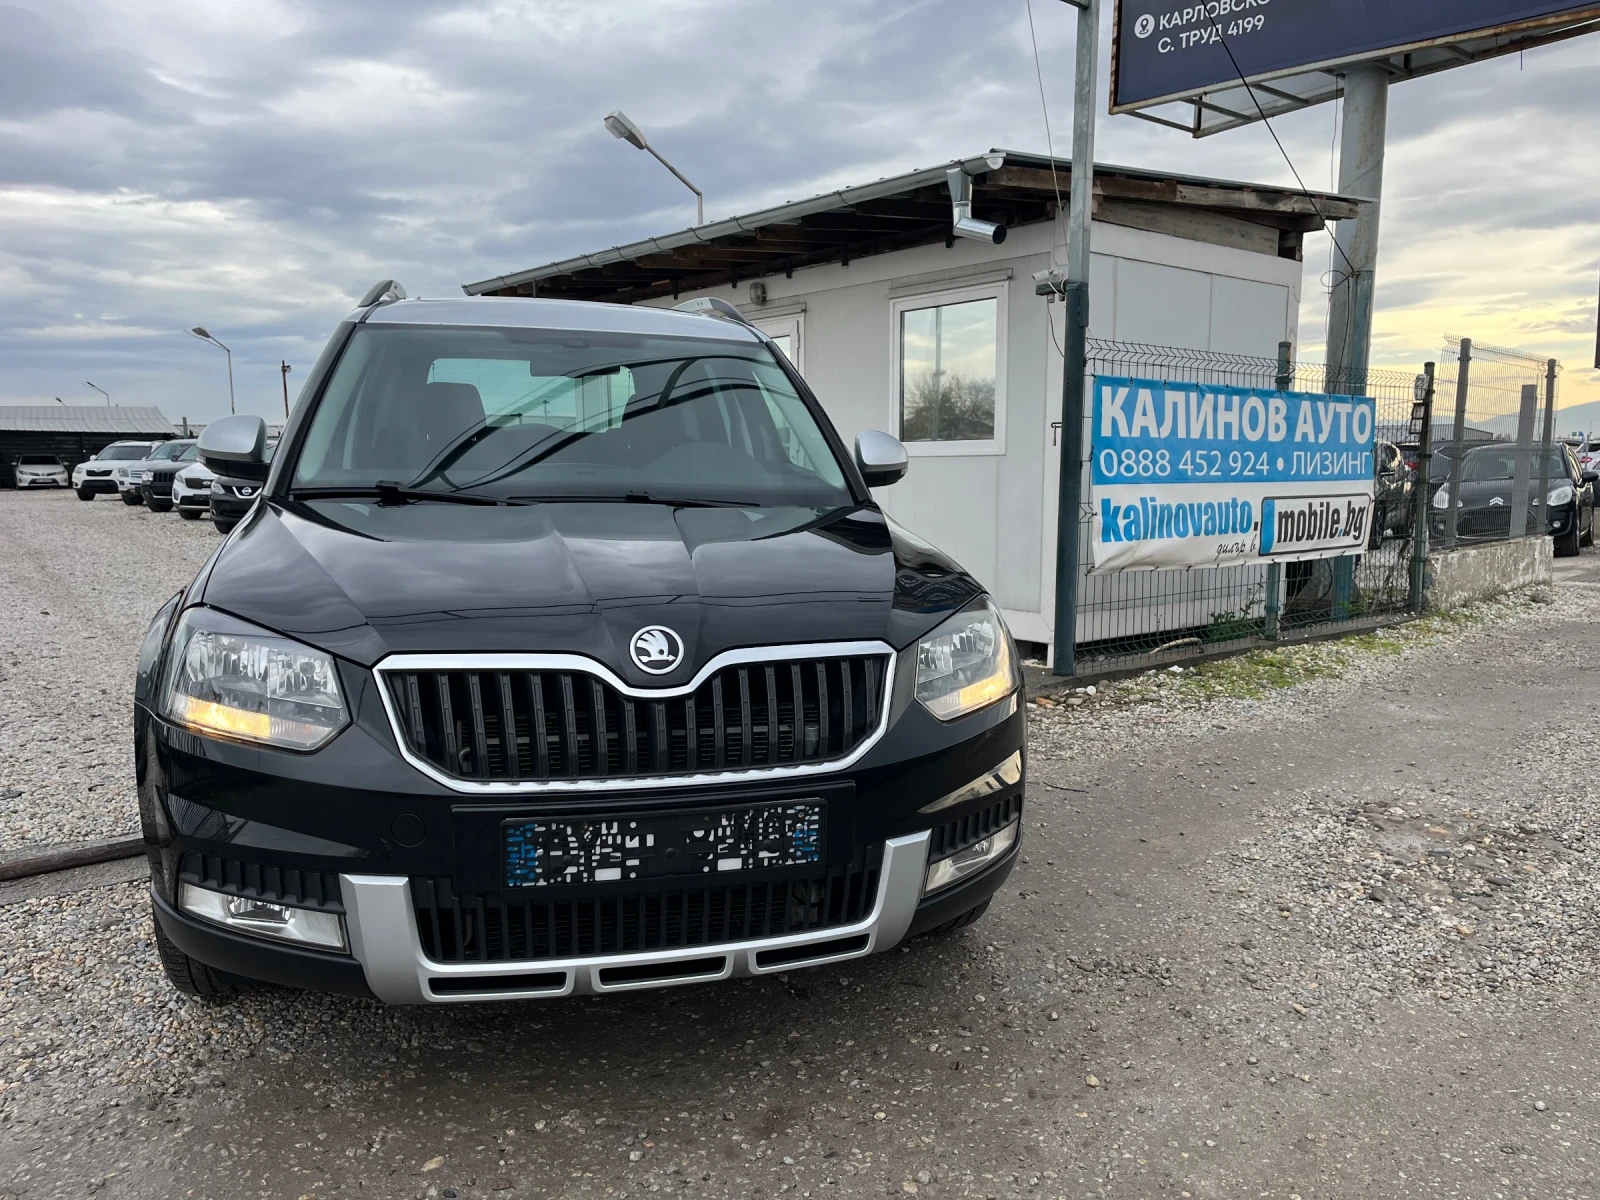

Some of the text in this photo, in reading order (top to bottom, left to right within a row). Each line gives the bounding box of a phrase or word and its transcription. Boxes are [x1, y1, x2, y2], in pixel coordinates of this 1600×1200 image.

[1159, 0, 1271, 31] КАРЛОВСК
[1157, 14, 1265, 53] С. ТРУД 4199
[1101, 385, 1371, 444] КАЛИНОВ АУТО
[1101, 448, 1370, 477] 0888 452 924 ЛИЗИНГ
